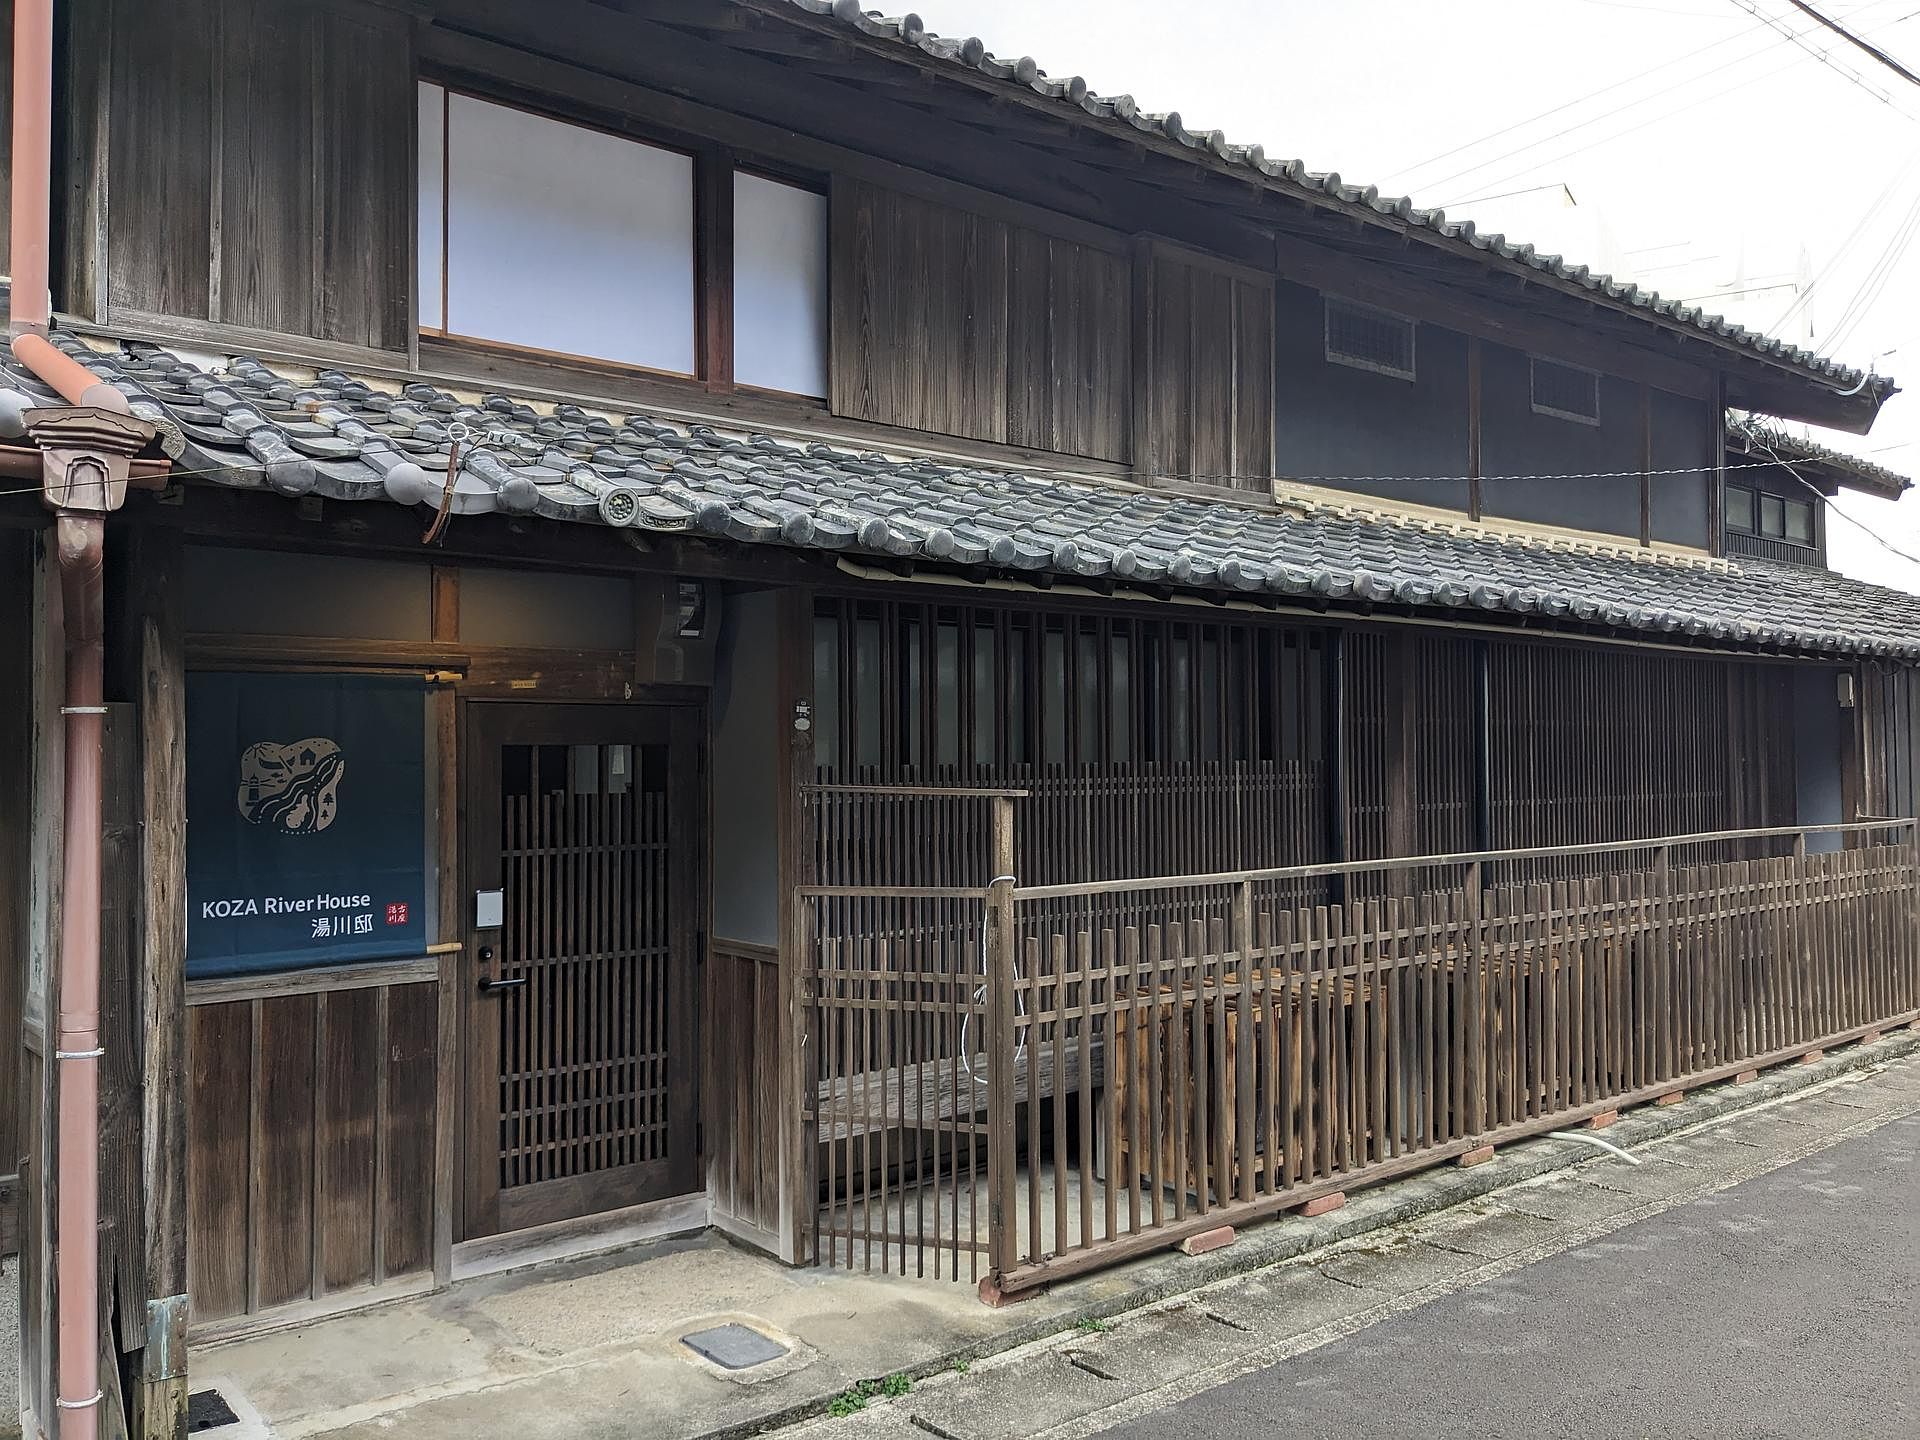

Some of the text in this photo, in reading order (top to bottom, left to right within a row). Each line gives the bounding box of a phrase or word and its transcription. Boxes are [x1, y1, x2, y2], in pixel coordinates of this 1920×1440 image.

[202, 893, 371, 919] KOZA River House
[311, 913, 374, 938] 湯川邸
